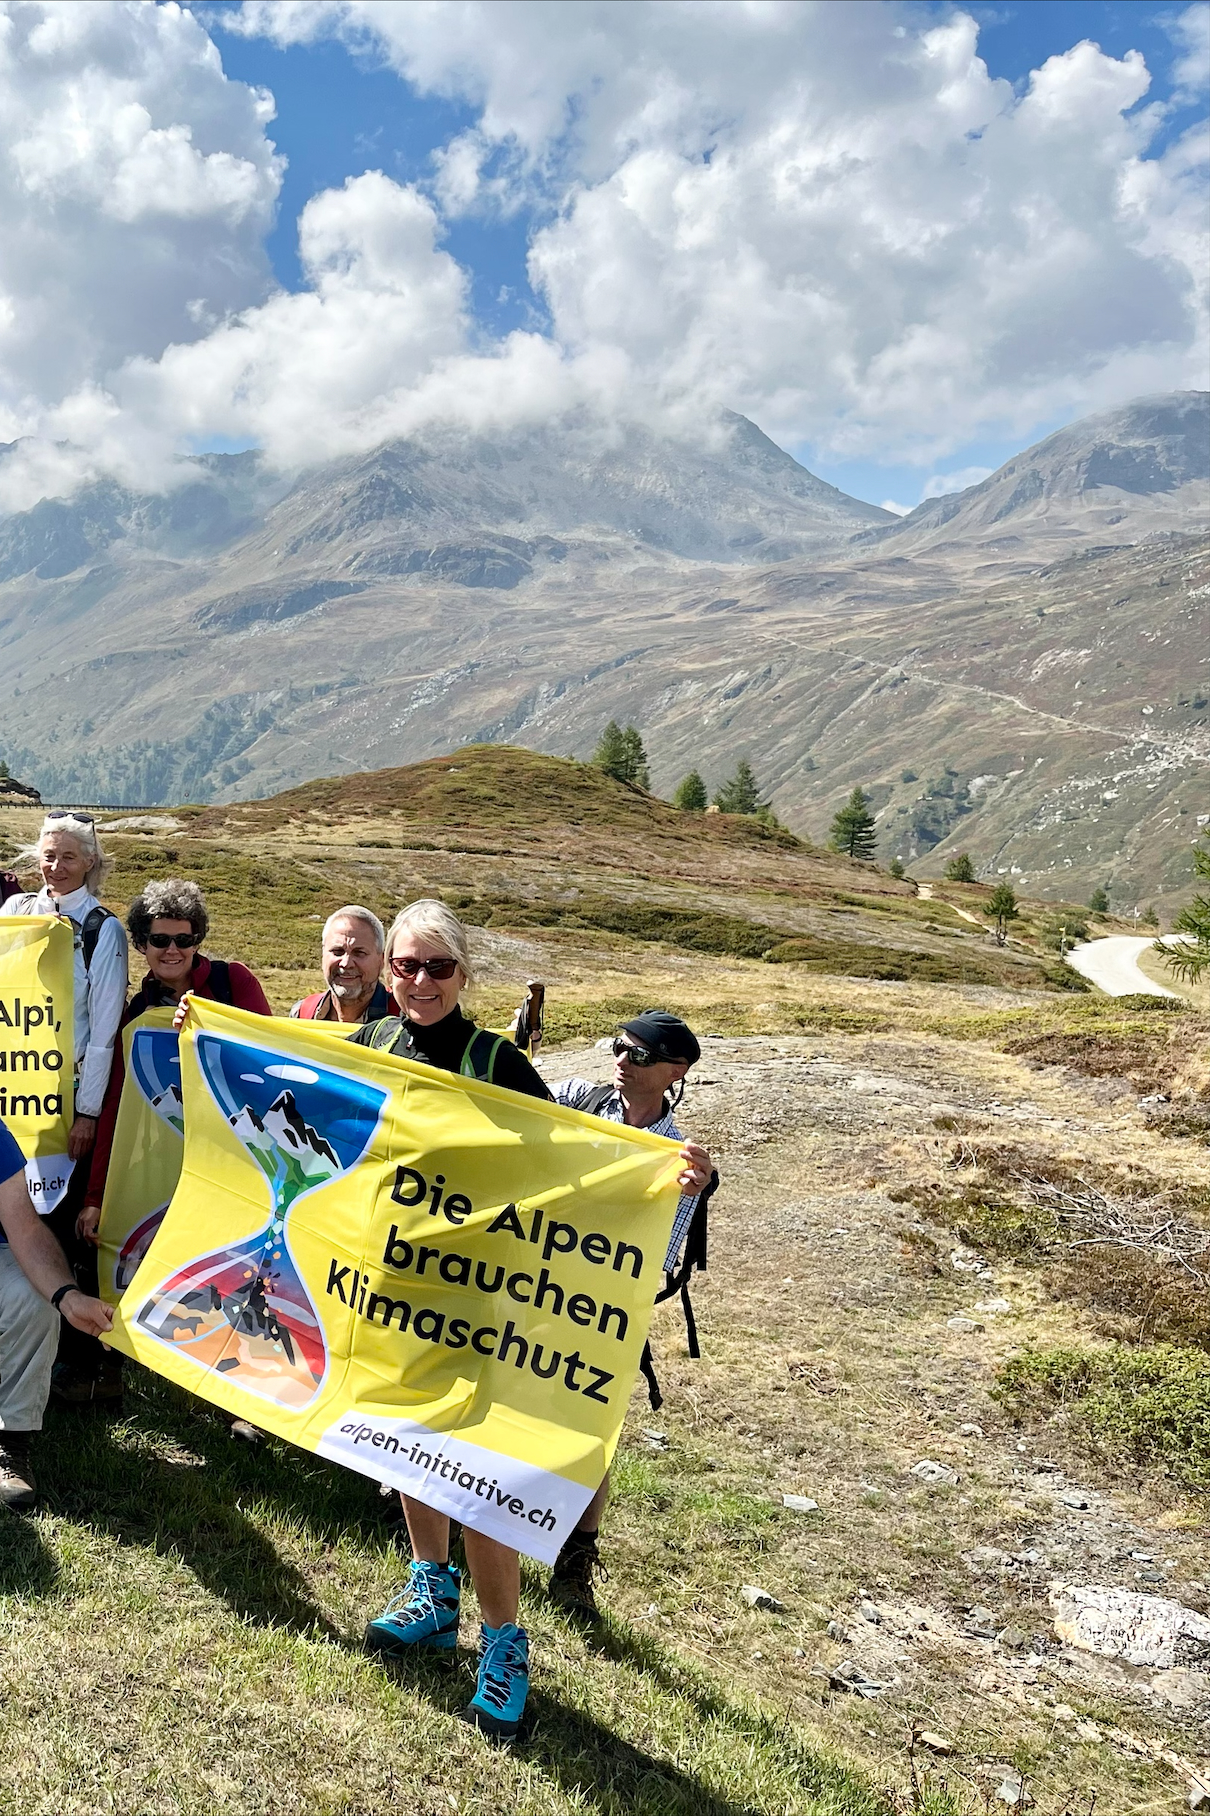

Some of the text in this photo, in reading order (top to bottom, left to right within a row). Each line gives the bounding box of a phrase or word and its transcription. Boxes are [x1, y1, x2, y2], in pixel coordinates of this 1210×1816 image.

[390, 1165, 645, 1279] Die Alpen
[326, 1258, 615, 1404] Klimaschutz
[383, 1224, 629, 1342] brauchen
[340, 1423, 558, 1532] alpen-initiative.ch
